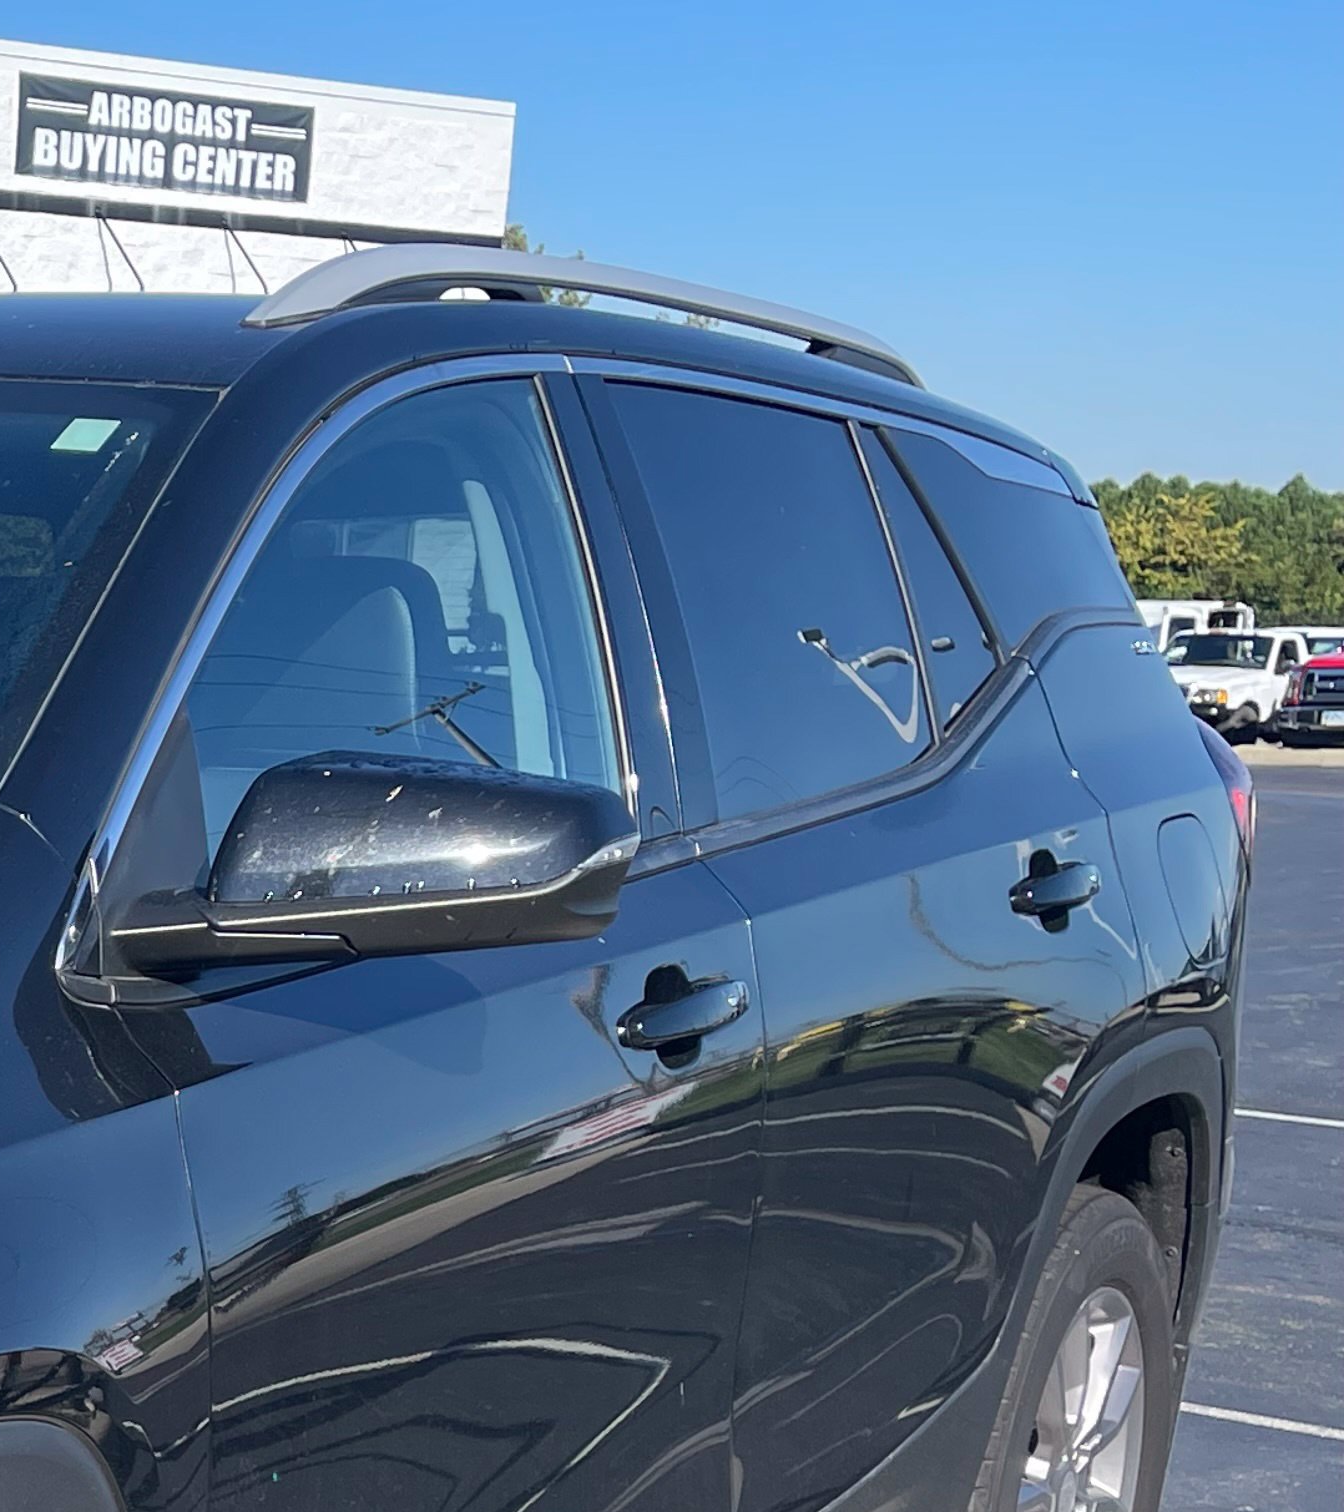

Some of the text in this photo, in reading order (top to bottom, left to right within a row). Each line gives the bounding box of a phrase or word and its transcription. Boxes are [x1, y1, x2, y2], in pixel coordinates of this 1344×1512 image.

[88, 90, 252, 142] ARBOGAST
[32, 126, 297, 193] BUYING CENTER
